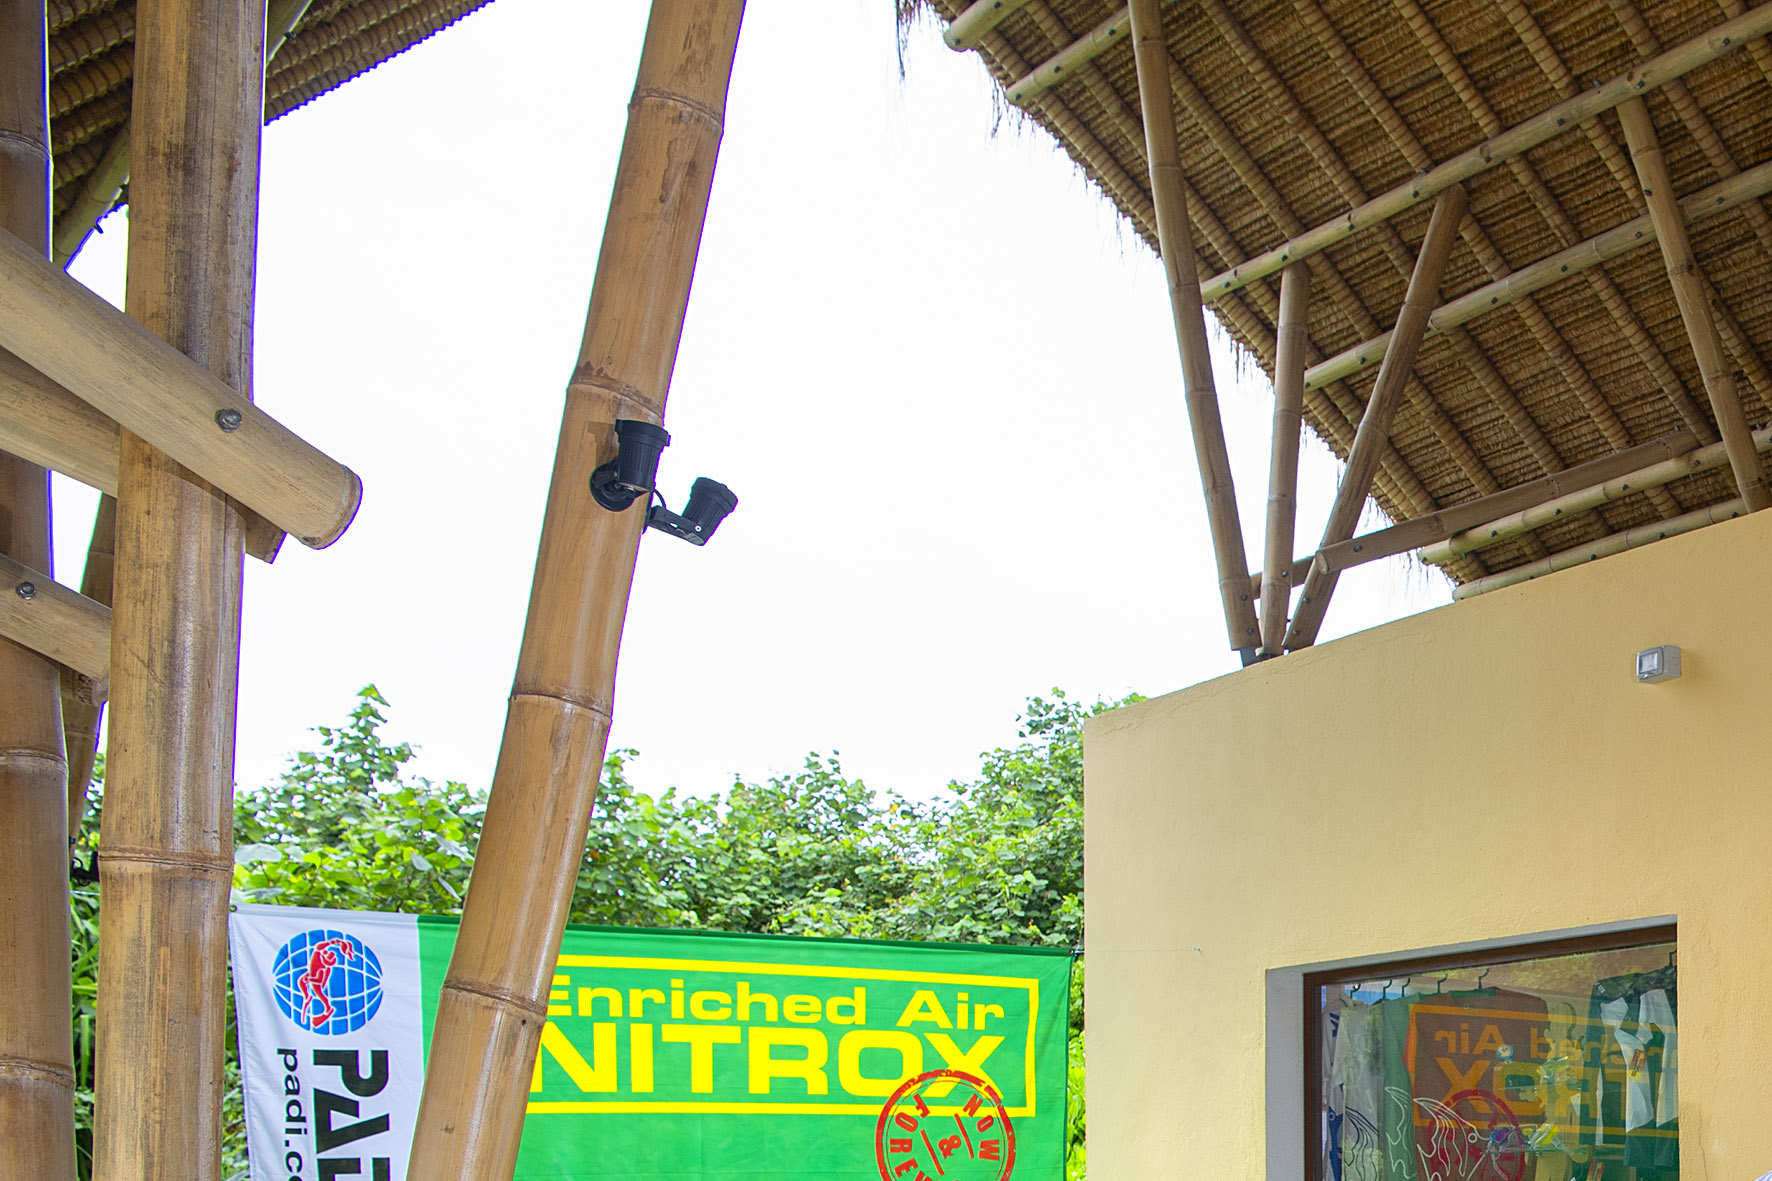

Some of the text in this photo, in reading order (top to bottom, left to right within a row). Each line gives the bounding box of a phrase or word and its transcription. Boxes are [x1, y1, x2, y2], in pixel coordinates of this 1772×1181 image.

[545, 974, 1004, 1031] Enriched Air
[528, 1021, 1006, 1100] NITROX
[937, 1134, 962, 1160] &
[963, 1093, 1000, 1162] NOW
